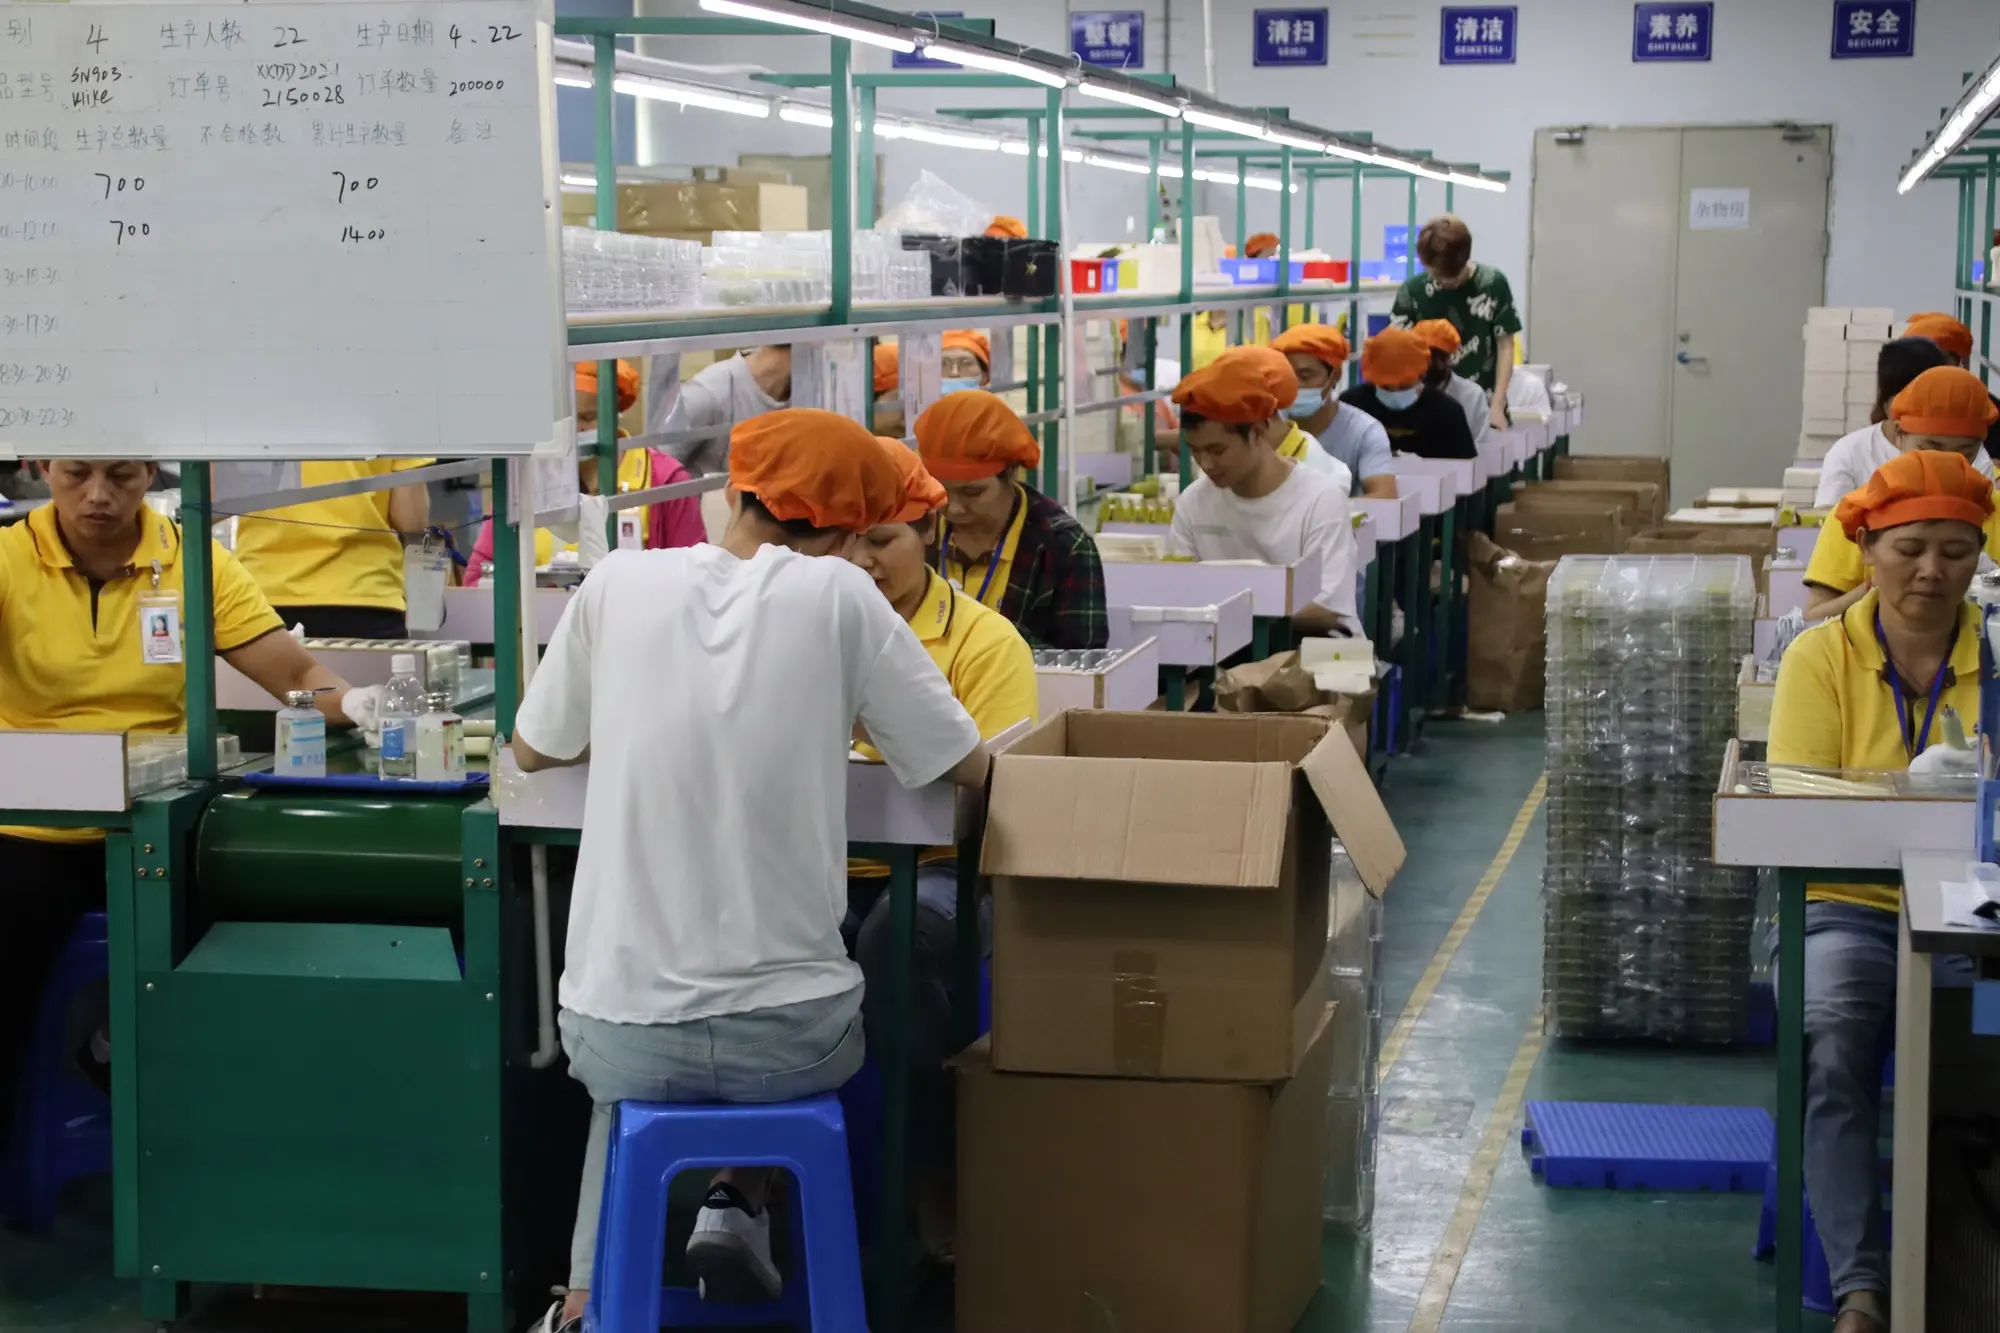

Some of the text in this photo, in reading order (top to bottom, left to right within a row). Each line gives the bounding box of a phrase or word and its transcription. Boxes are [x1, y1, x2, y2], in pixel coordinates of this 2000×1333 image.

[86, 23, 109, 54] 4
[160, 18, 247, 49] 生产人数
[273, 26, 308, 48] 22
[356, 18, 434, 49] 生产日期
[1267, 19, 1315, 45] 清扫
[1455, 16, 1504, 43] 清洁
[1649, 13, 1698, 39] 素养
[1849, 9, 1900, 36] 安全
[1847, 36, 1899, 49] SECURITY
[167, 71, 232, 102] 订单号
[262, 84, 345, 107] 2150028
[357, 67, 505, 98] 订单数量 200000
[5, 117, 496, 153] 时间段 生产总数量 不合格数 累计生产数量 备注
[95, 172, 146, 200] 700
[332, 171, 379, 204] 700
[110, 219, 150, 245] 700
[341, 225, 385, 244] 1400
